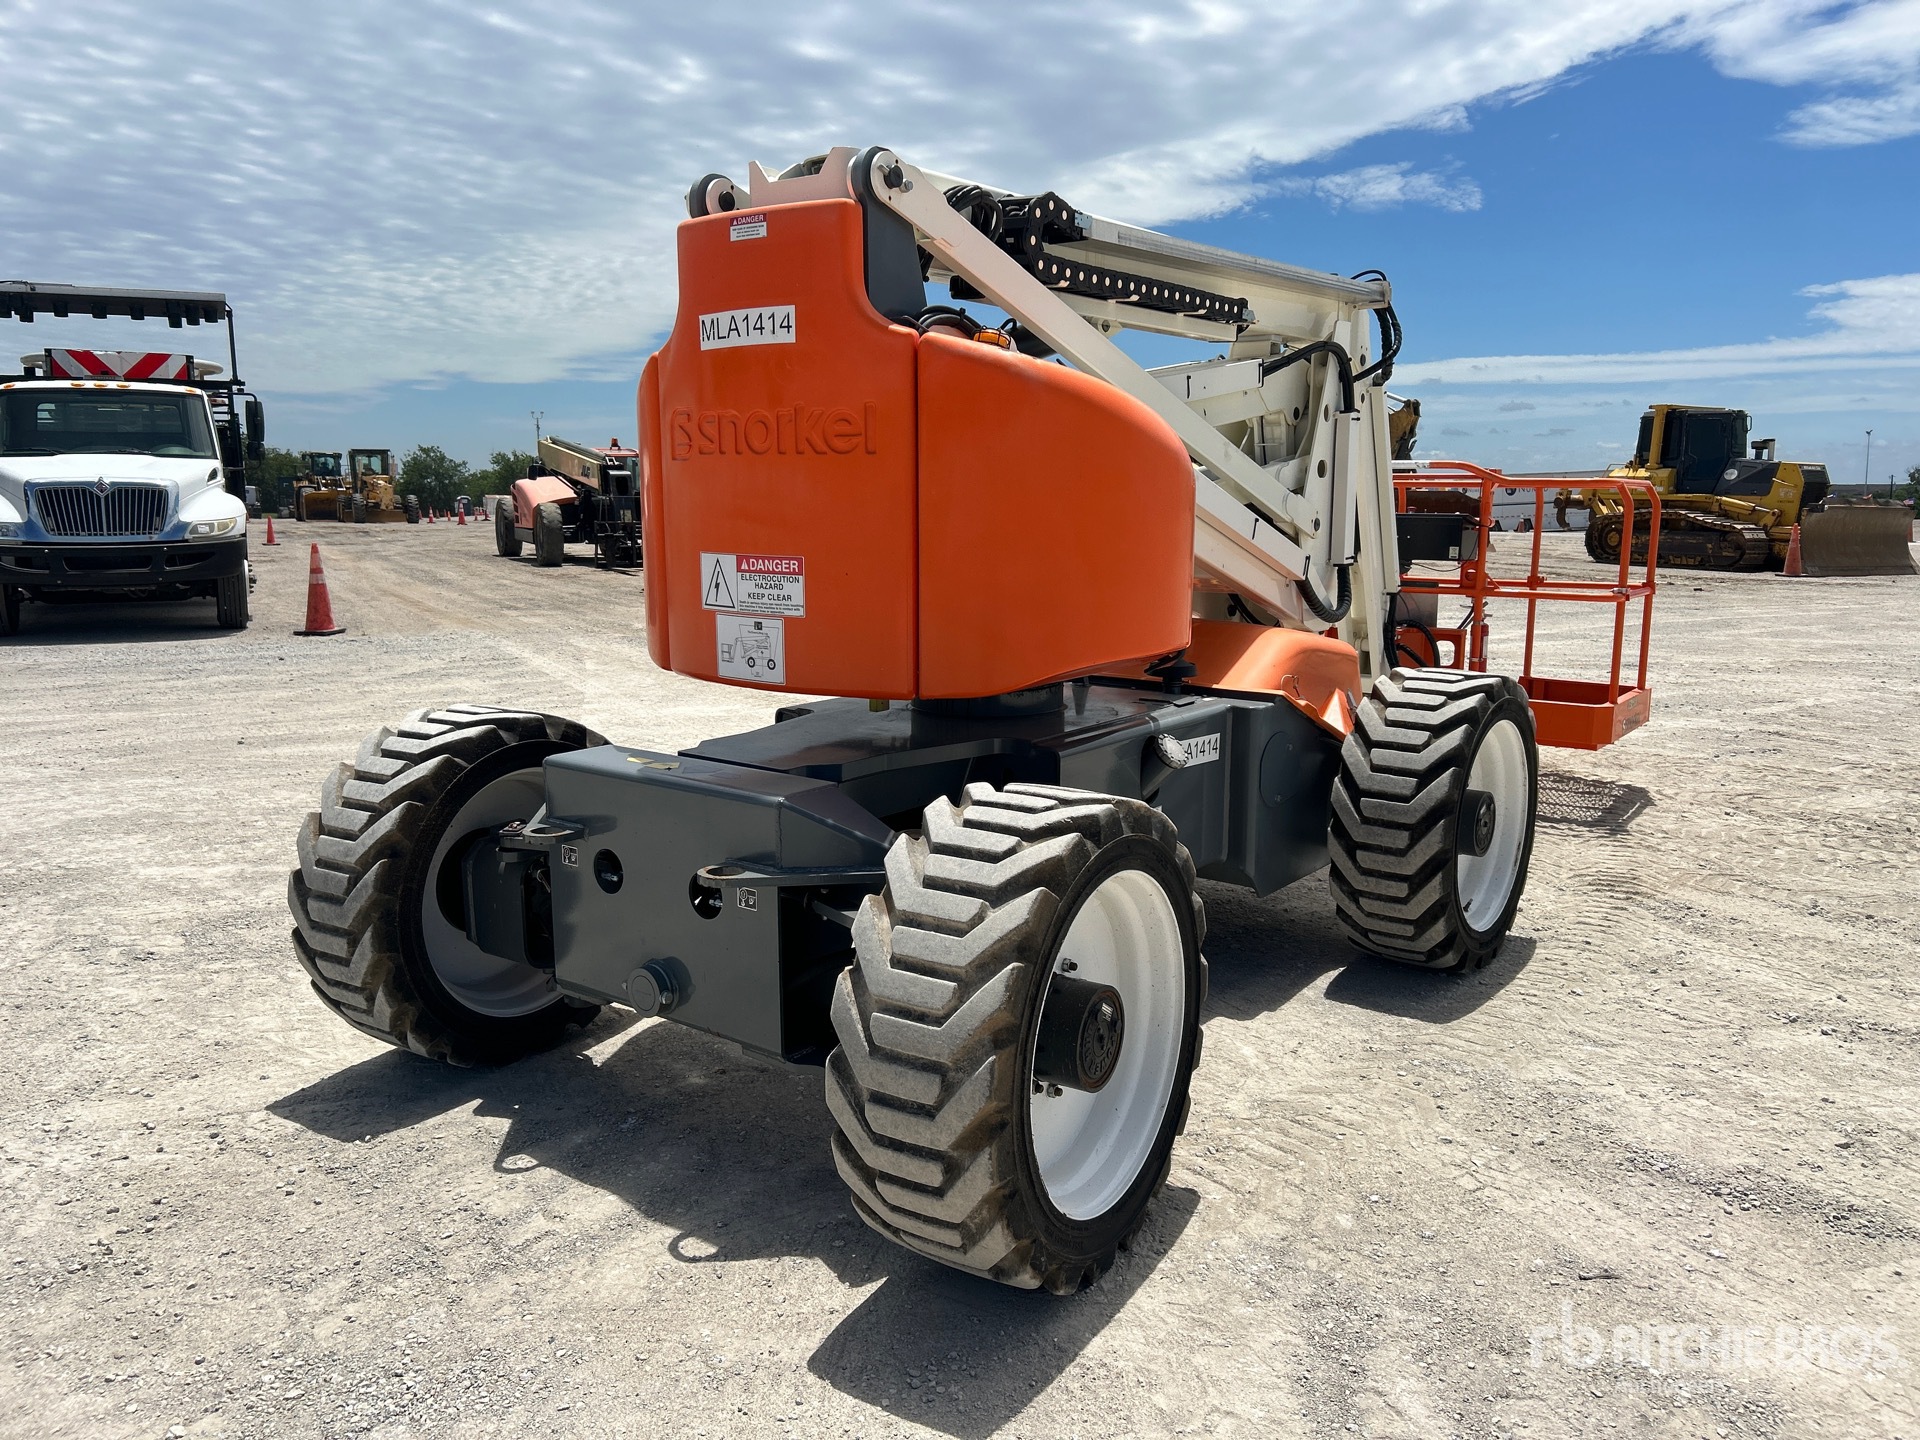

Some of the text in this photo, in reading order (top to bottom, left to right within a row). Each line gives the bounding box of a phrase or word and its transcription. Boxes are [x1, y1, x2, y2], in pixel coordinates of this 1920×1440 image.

[738, 215, 764, 225] DANGER
[701, 312, 793, 342] MLA1414
[697, 401, 877, 455] snorkel
[749, 558, 799, 572] DANGER
[740, 573, 800, 584] ELECTROCUTION
[754, 582, 784, 591] HAZARD
[747, 592, 792, 602] KEEP CLEAR
